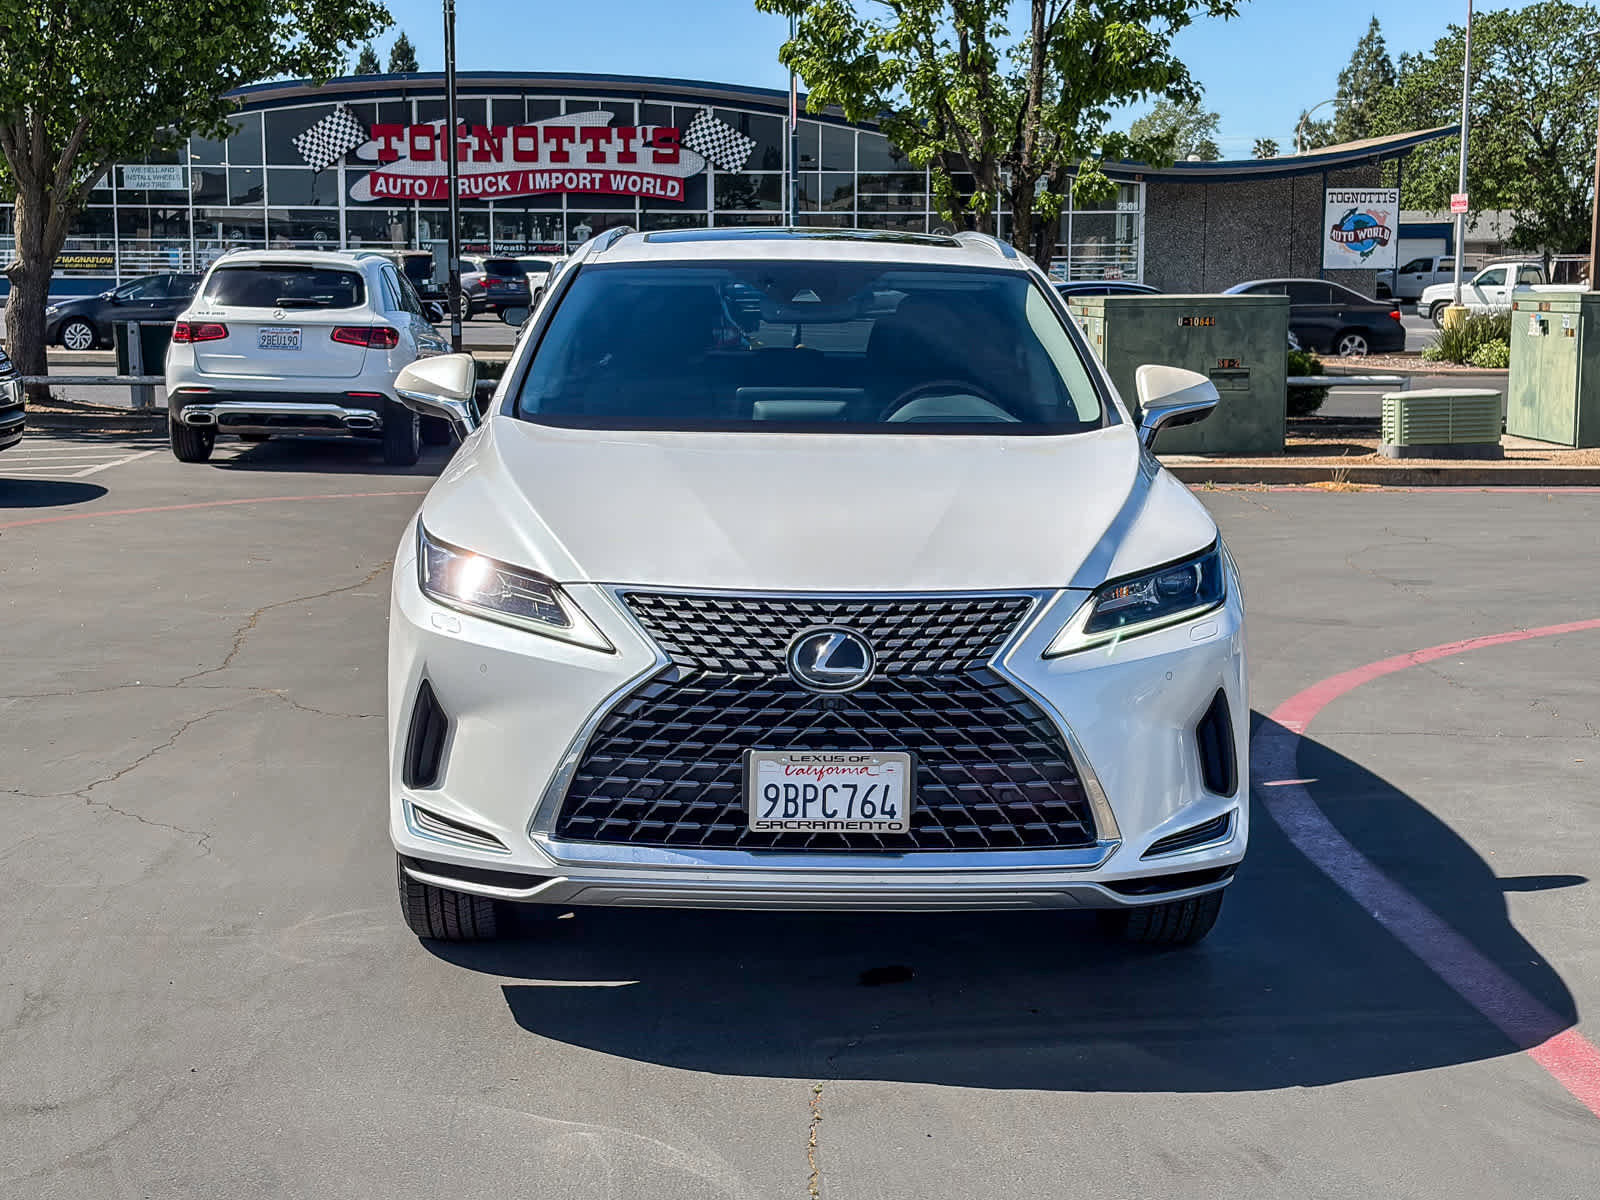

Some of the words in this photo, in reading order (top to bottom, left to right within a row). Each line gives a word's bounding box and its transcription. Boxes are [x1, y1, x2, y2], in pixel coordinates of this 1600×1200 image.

[370, 124, 680, 164] TOGNOTTI'S
[374, 175, 428, 196] AUTO
[444, 174, 512, 195] RUCK
[528, 172, 603, 190] IMPORT
[610, 173, 680, 197] WORLD
[1328, 190, 1397, 204] TOGNOTTI'S
[1331, 230, 1355, 242] AUTO
[1356, 226, 1390, 240] WORLD
[261, 335, 298, 346] 9BEU190
[790, 755, 845, 763] LEXUS
[848, 755, 870, 763] OF
[785, 765, 880, 782] California
[763, 783, 897, 820] 9BPC764
[755, 820, 903, 831] SACRAMENTO
